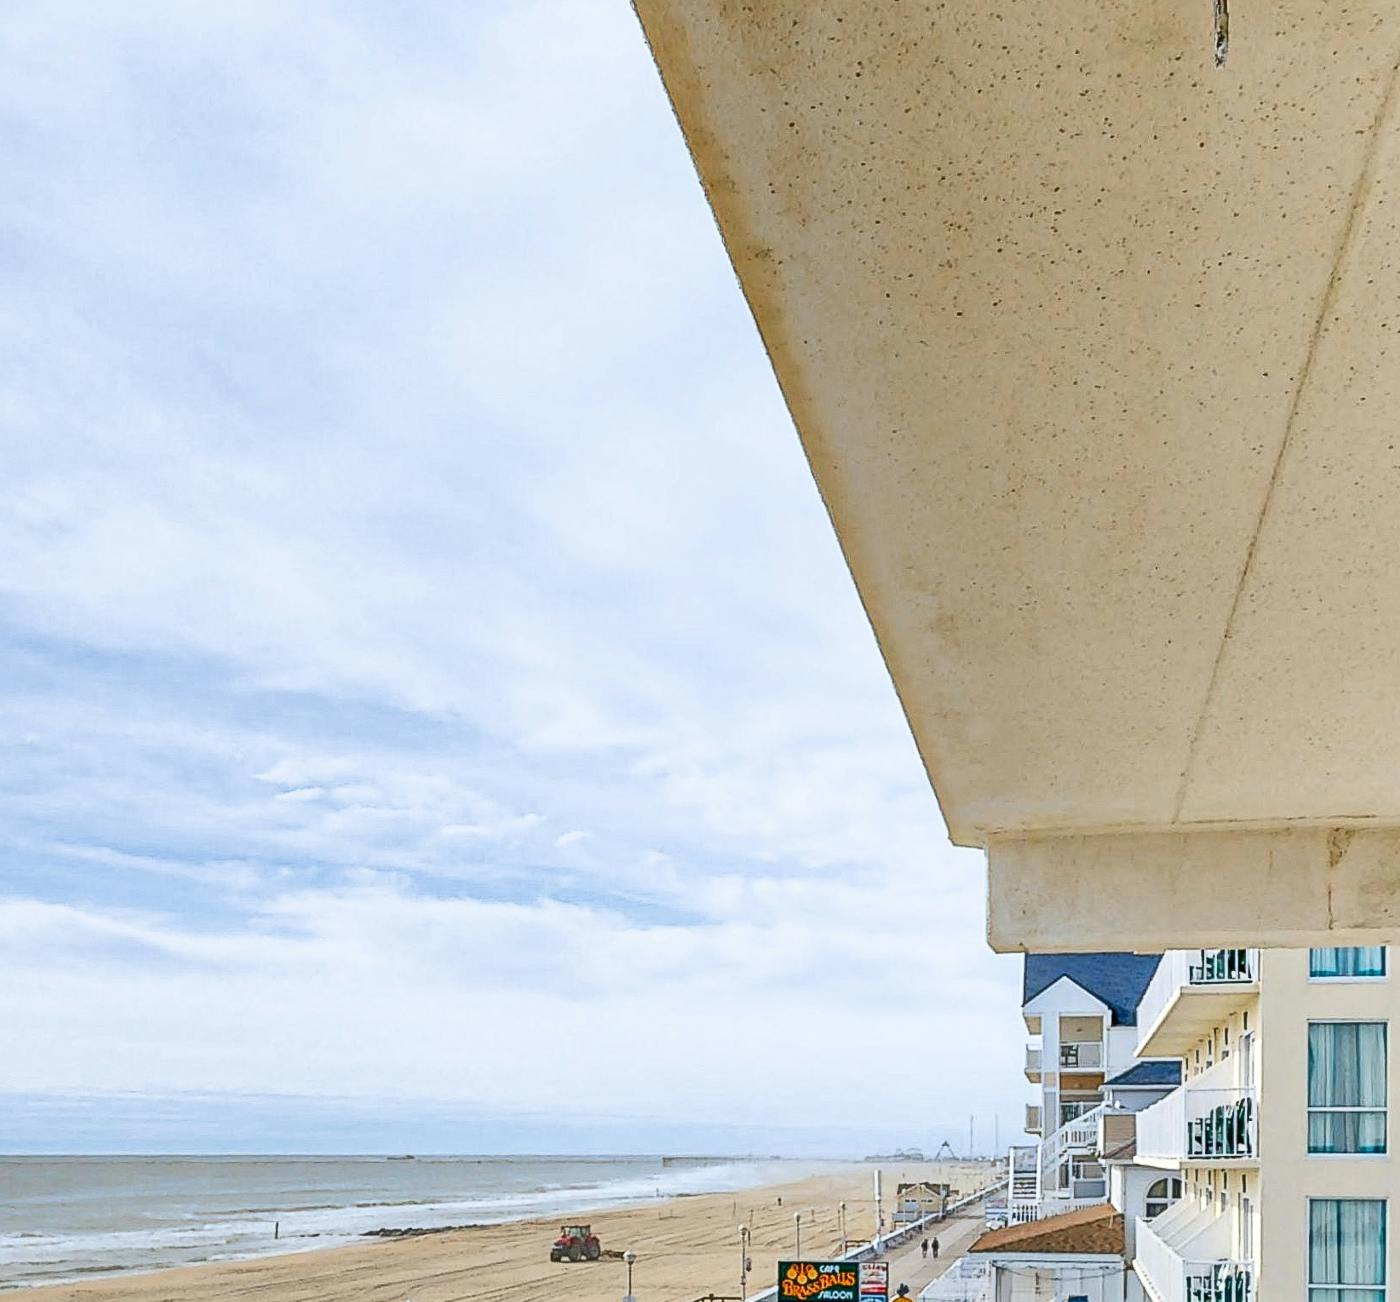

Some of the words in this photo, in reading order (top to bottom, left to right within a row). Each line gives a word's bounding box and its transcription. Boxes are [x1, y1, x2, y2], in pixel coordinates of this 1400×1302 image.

[782, 1279, 821, 1300] BRASS
[819, 1272, 855, 1290] BALLS
[817, 1291, 853, 1299] SALOON
